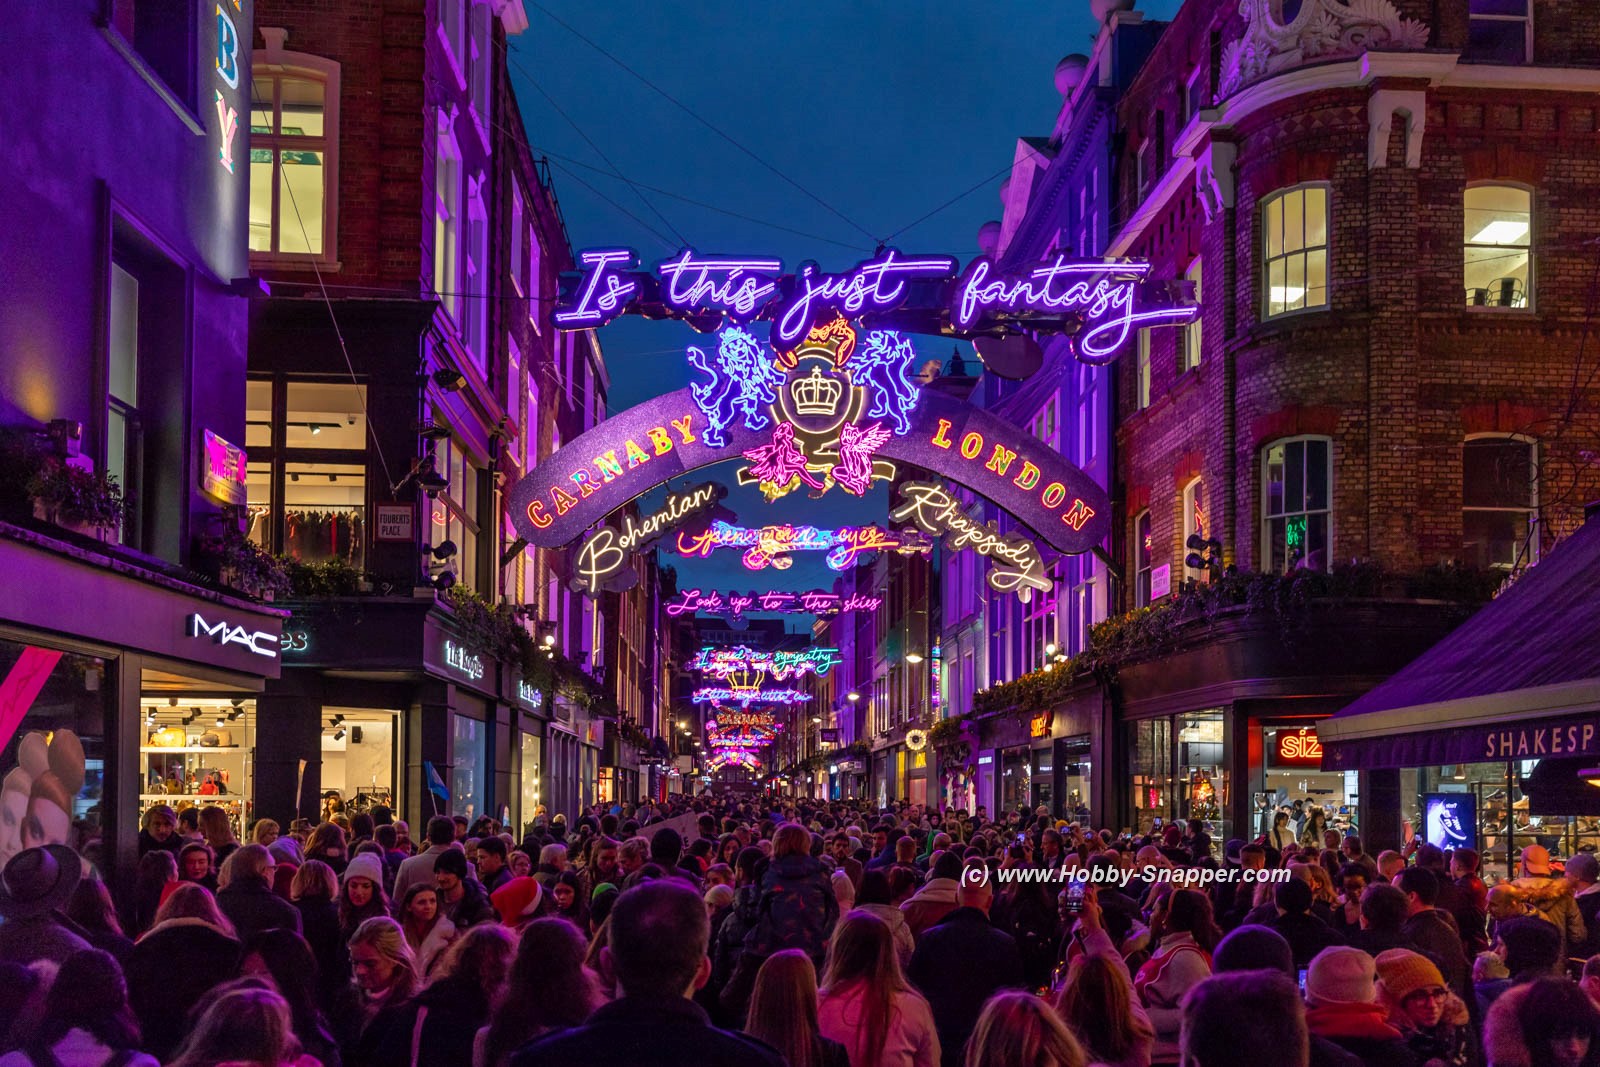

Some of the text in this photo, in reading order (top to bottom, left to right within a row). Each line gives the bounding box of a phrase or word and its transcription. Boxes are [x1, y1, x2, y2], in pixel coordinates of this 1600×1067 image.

[556, 250, 1197, 357] Is this just fantasy
[527, 414, 696, 529] CARNABY
[932, 418, 1095, 531] LONDON
[380, 513, 410, 525] FOUBERTS
[381, 525, 401, 537] PLACE
[578, 485, 713, 593] Bohemian
[895, 485, 1049, 589] Rhapsody
[748, 526, 826, 567] your
[832, 526, 899, 568] eyes
[667, 590, 882, 615] Look up to the skies
[771, 647, 843, 674] sympathy
[1486, 724, 1594, 757] SHAKESP
